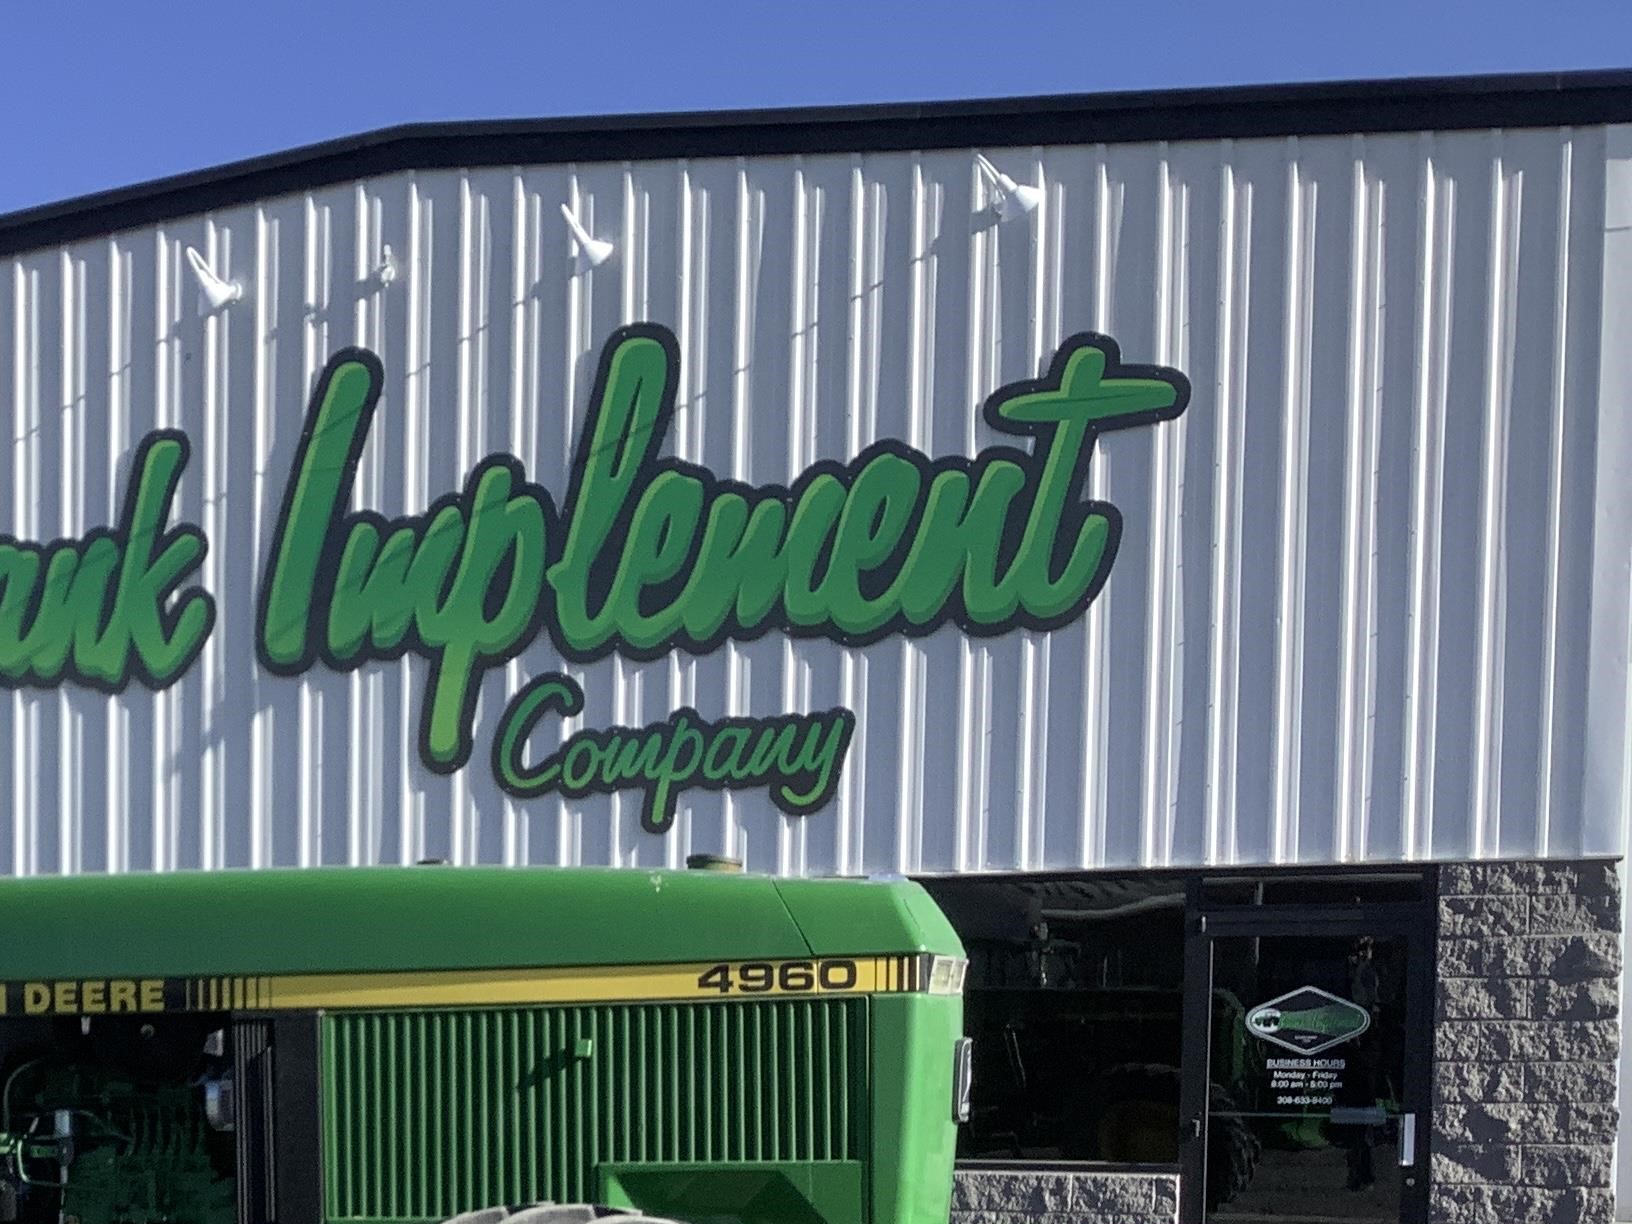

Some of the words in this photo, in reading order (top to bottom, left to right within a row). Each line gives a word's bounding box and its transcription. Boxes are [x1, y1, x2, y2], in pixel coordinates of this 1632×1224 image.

[258, 322, 1190, 770] Implement
[494, 673, 854, 832] Company
[698, 960, 857, 993] 4960
[24, 979, 165, 1013] DEERE
[1267, 1059, 1311, 1069] BUSINESS
[1313, 1059, 1345, 1069] HOURS
[1273, 1071, 1306, 1080] Monday
[1312, 1070, 1338, 1080] Friday
